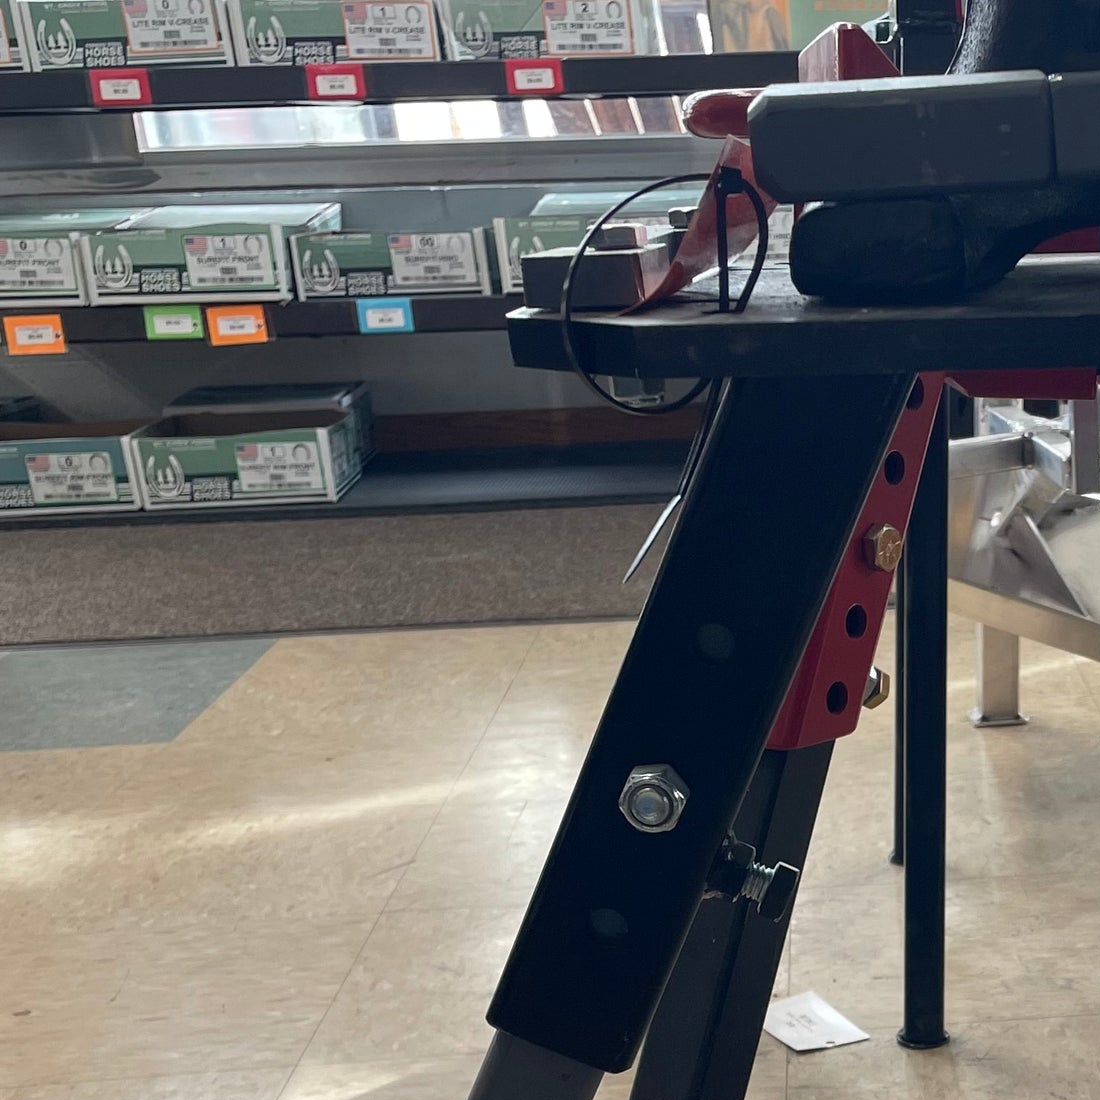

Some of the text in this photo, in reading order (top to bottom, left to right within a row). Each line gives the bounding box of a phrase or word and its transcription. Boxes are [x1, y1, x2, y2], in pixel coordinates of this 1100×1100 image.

[581, 3, 589, 13] 2
[85, 46, 124, 58] HORSE
[294, 45, 333, 57] HORSE
[86, 56, 126, 67] SHOES
